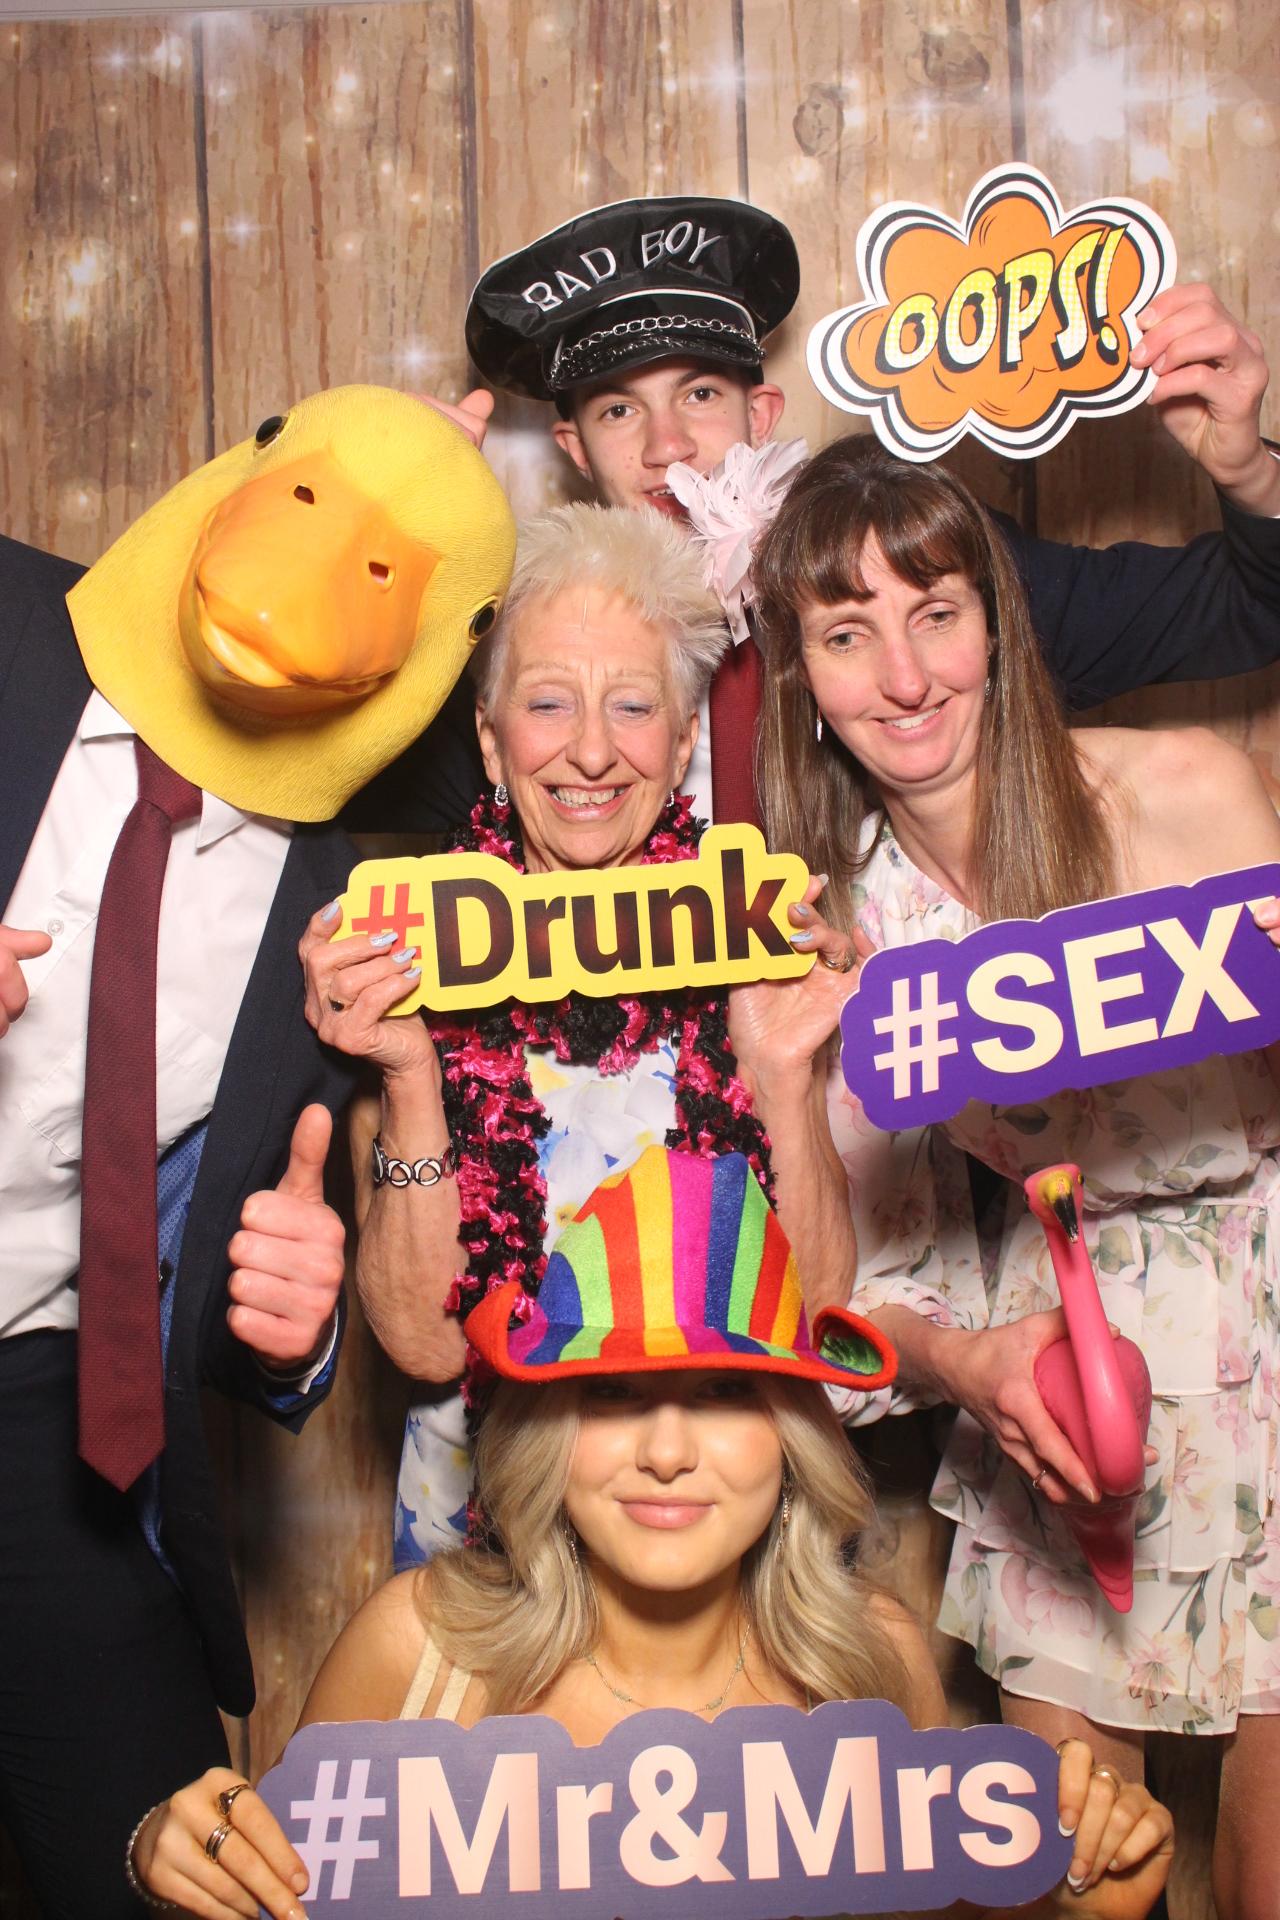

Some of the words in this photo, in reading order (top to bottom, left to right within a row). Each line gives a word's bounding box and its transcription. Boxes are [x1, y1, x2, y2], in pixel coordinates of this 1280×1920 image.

[521, 246, 617, 312] BAD
[640, 220, 724, 268] BOY
[875, 222, 1130, 374] OOPS!
[351, 847, 796, 988] #Drunk
[872, 896, 1280, 1100] #SEX
[289, 1735, 1041, 1902] #Mr&Mrs
